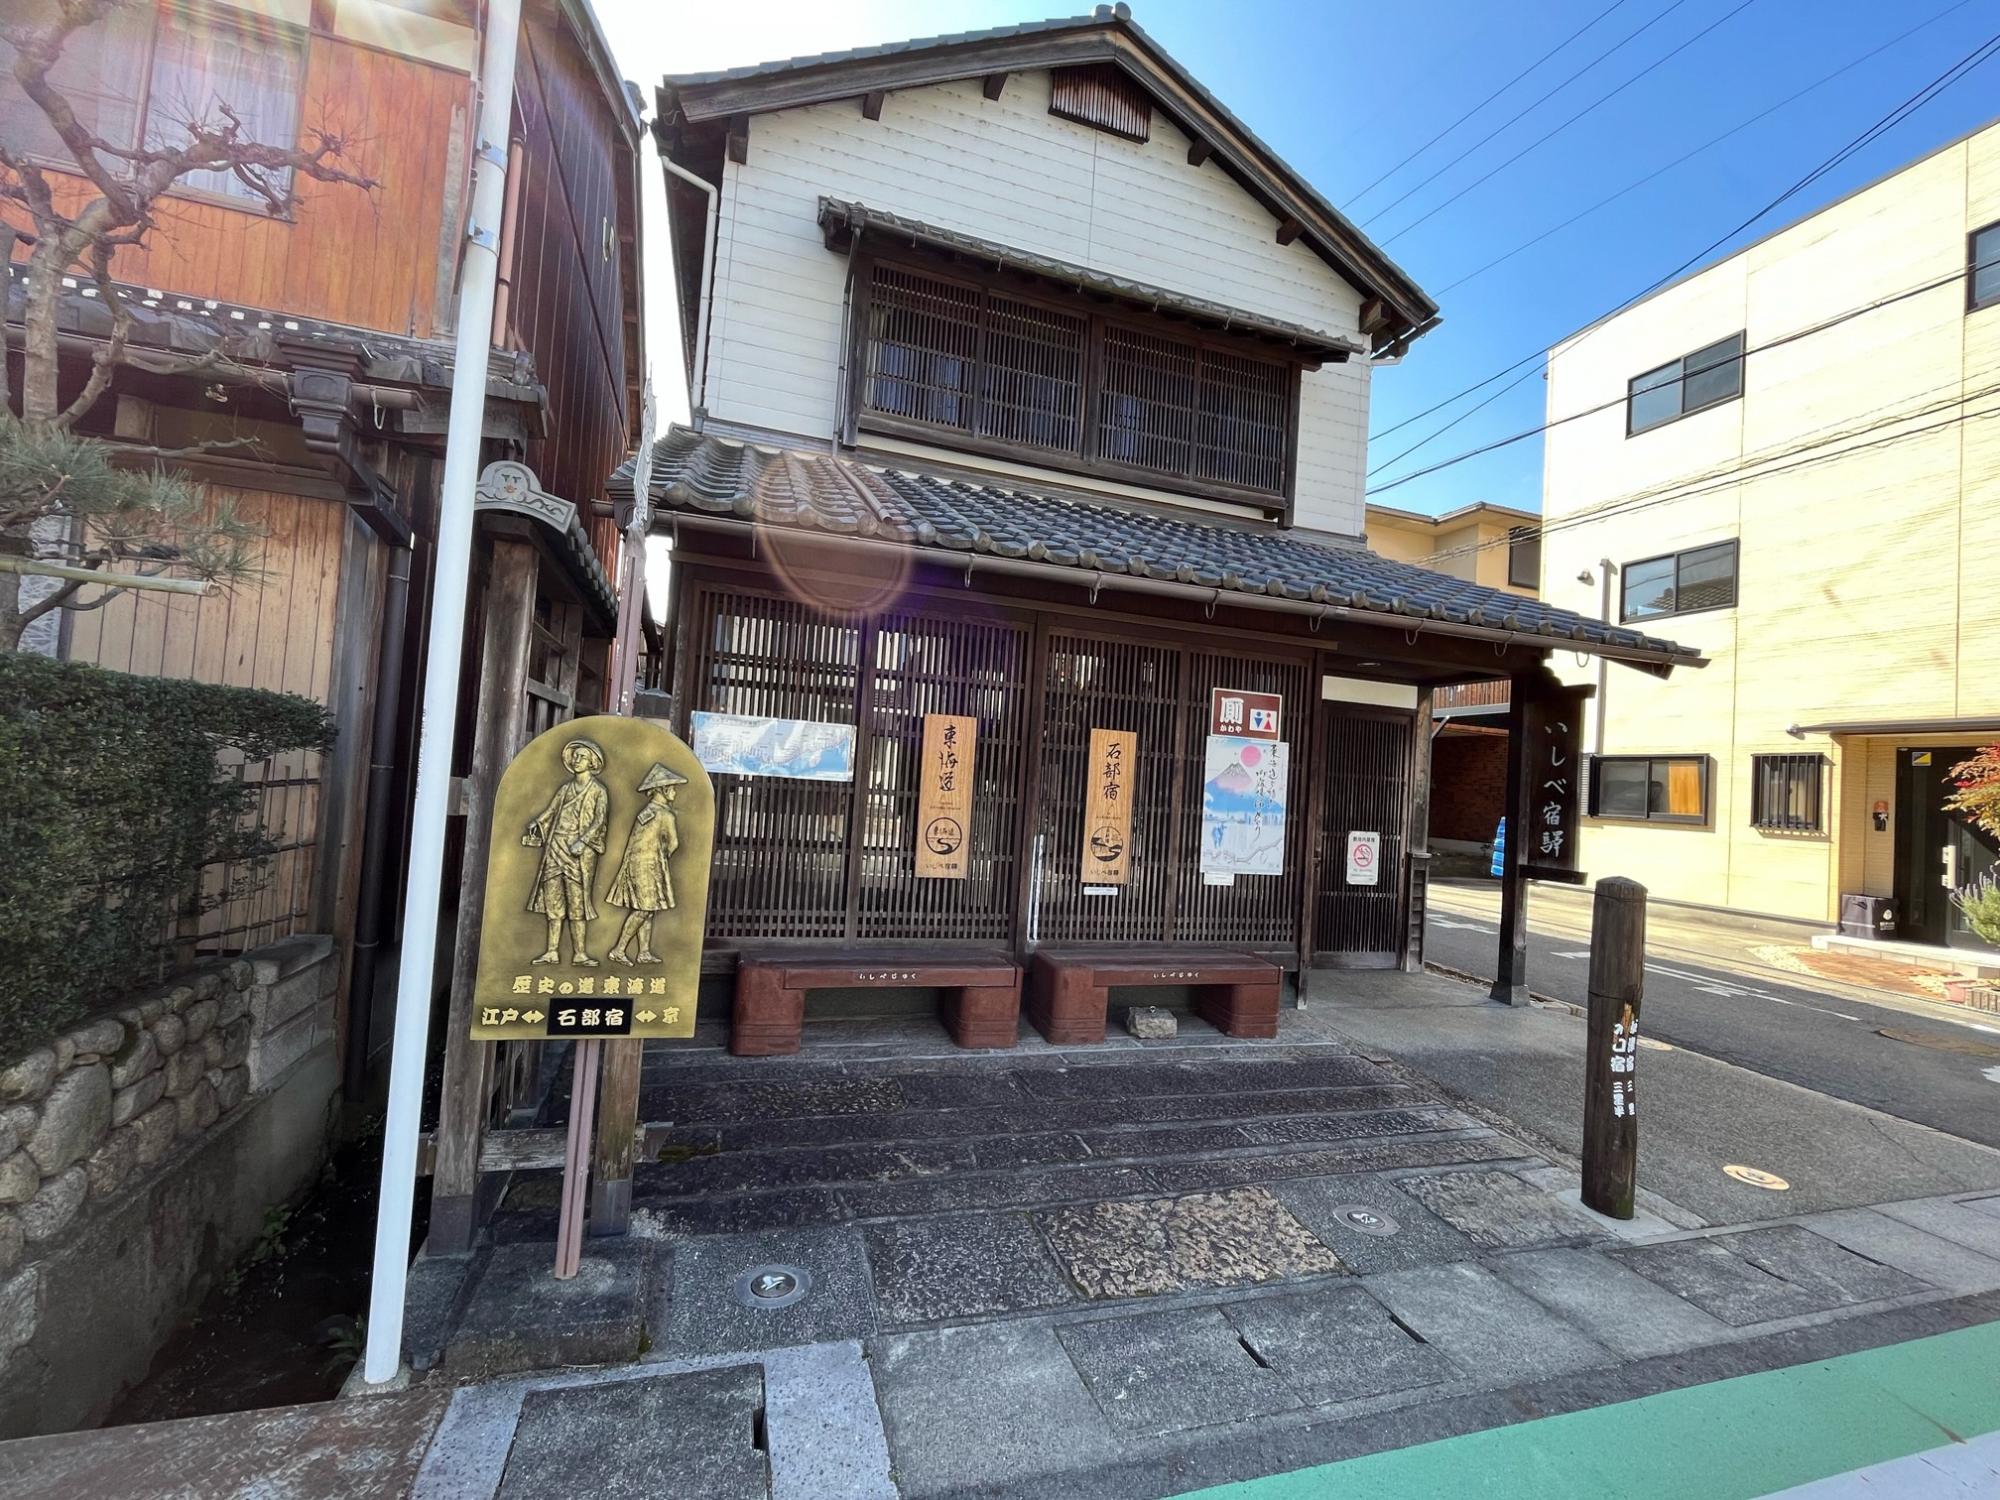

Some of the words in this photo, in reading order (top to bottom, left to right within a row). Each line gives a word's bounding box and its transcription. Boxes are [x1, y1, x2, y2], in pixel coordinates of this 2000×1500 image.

[1219, 725, 1242, 733] かわや
[938, 724, 959, 792] 東海道
[1102, 742, 1121, 801] 石部宿
[481, 1007, 519, 1026] 江戸
[557, 1008, 625, 1027] 石部宿
[662, 1006, 680, 1024] 京
